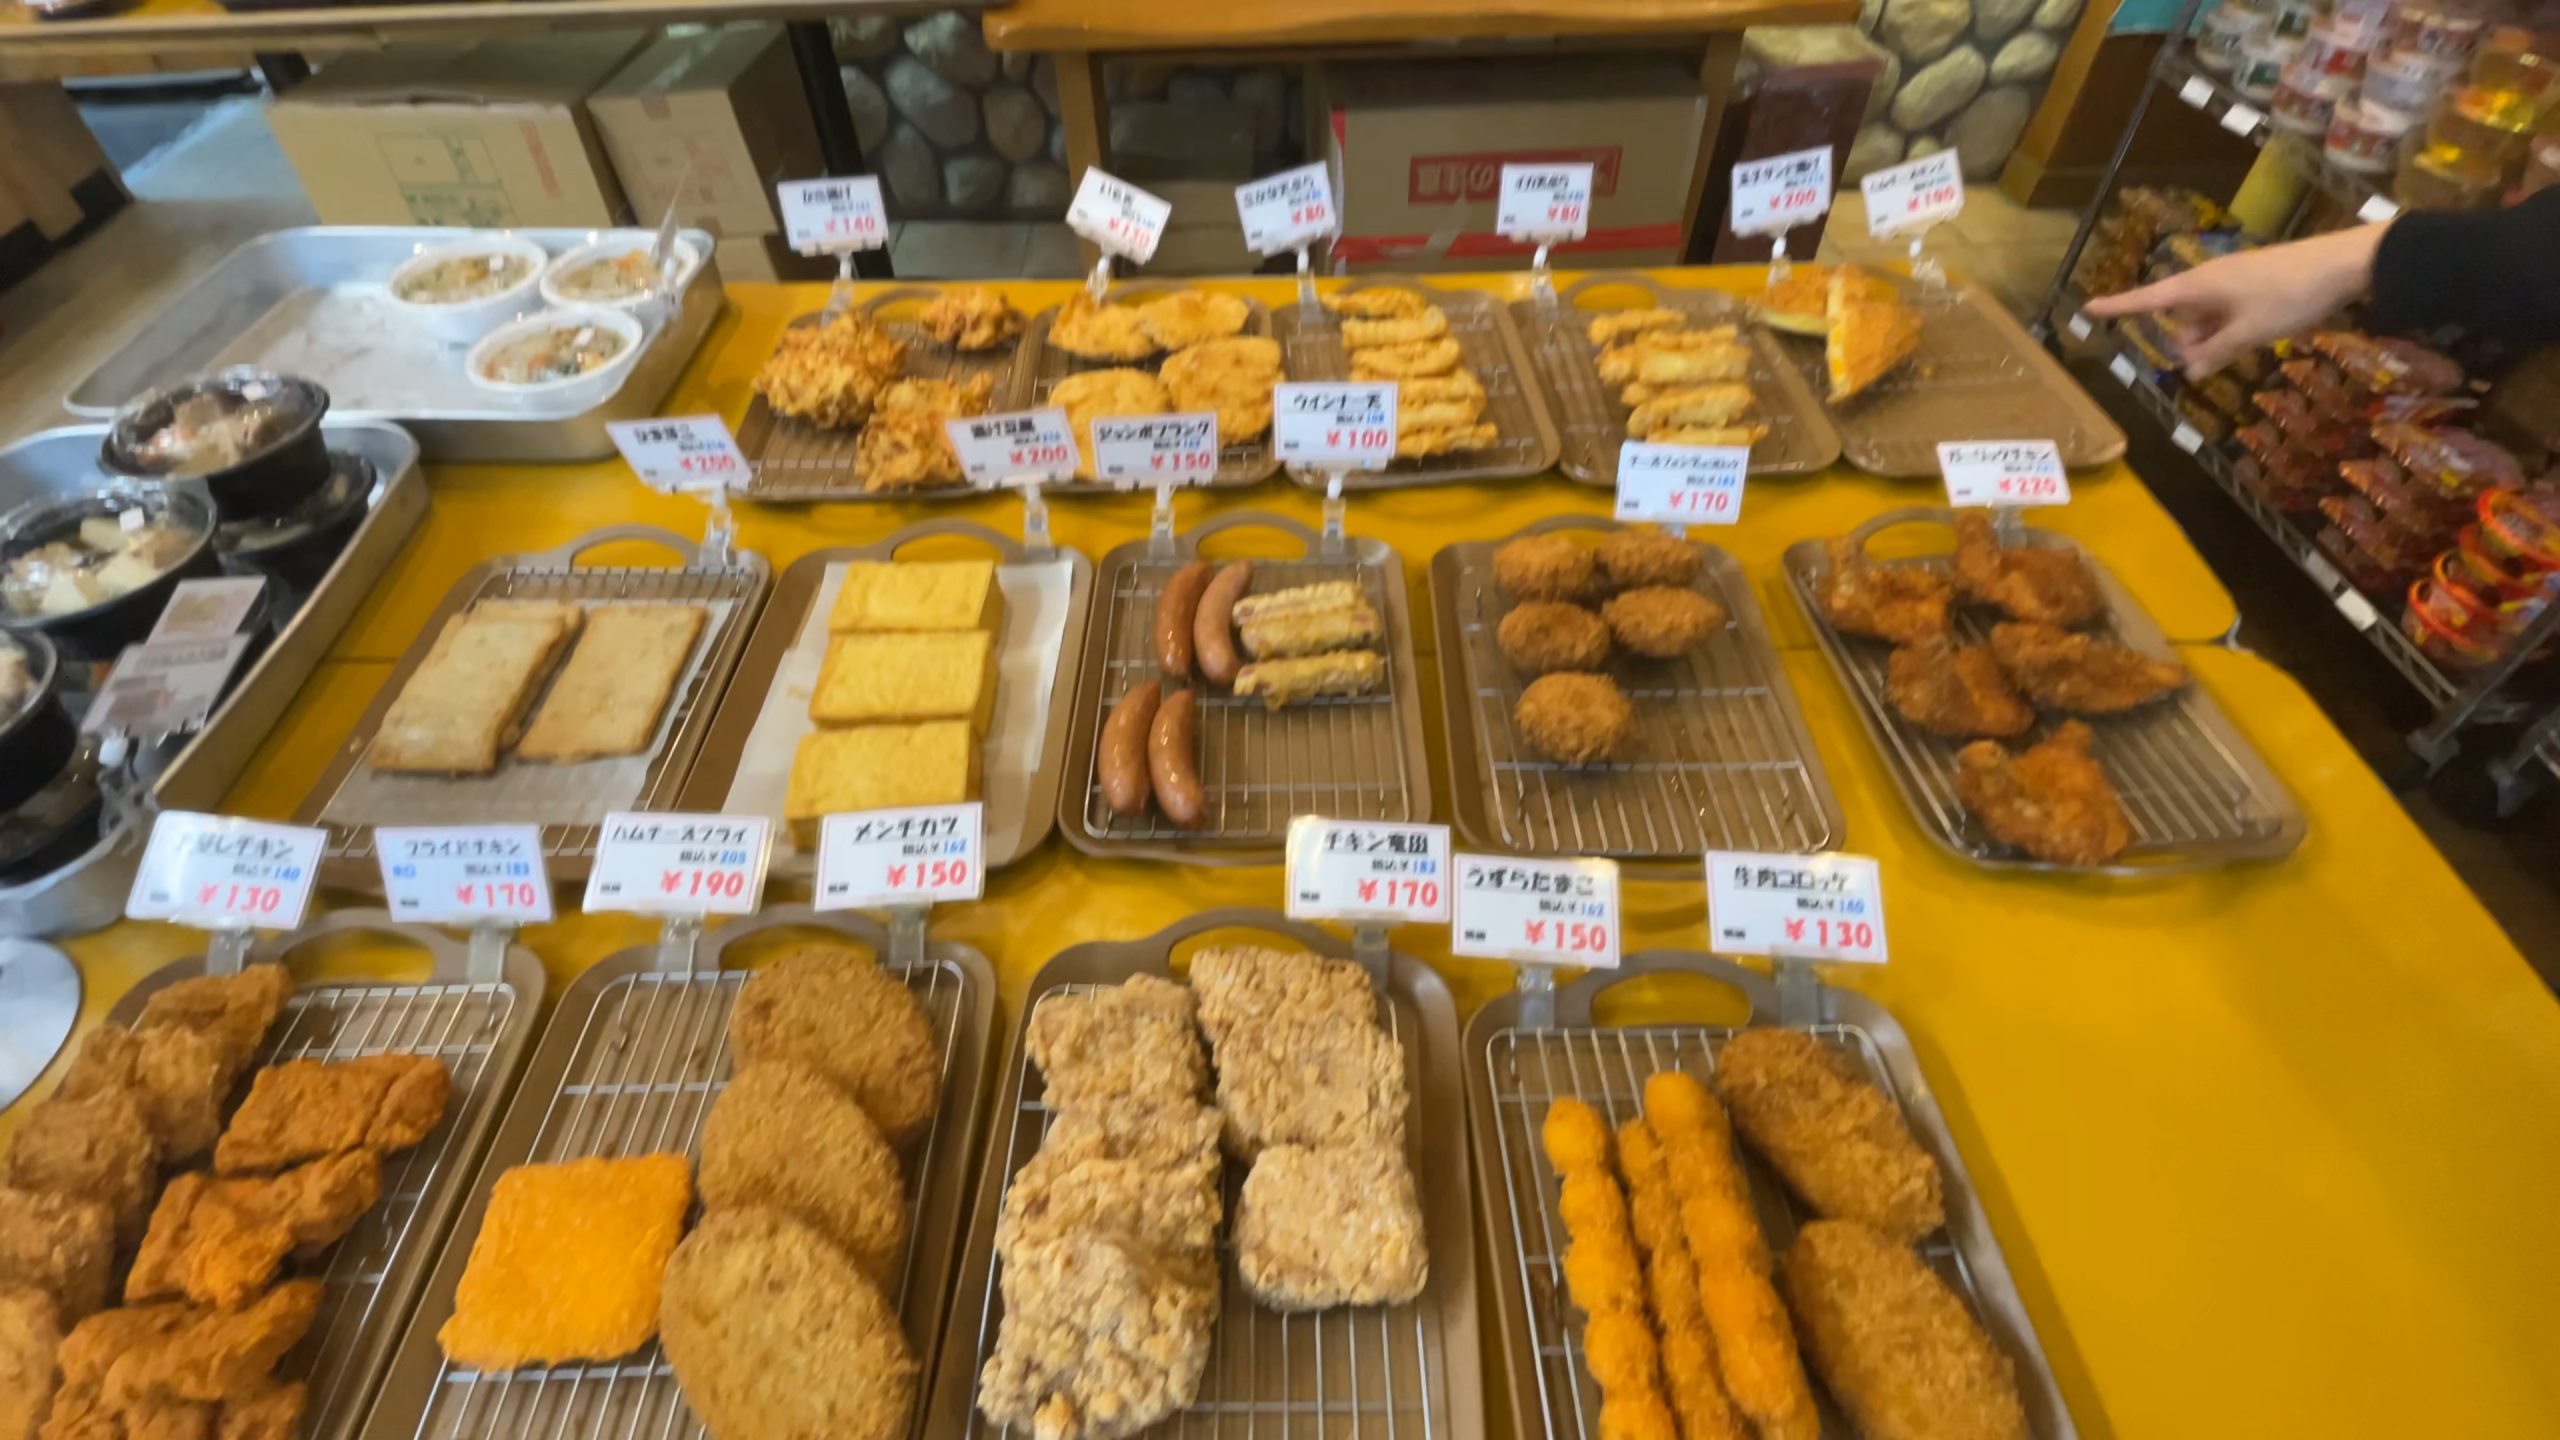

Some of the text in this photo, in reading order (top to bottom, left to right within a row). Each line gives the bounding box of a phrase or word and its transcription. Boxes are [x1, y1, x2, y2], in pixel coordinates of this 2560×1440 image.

[1327, 429, 1388, 450] ¥100
[1669, 491, 1728, 511] ¥170
[661, 870, 744, 898] ¥190
[887, 859, 967, 889] ¥150
[200, 883, 281, 913] ¥130
[456, 883, 535, 908] ¥170
[1359, 879, 1438, 907] ¥170
[1526, 919, 1607, 953] ¥150
[1784, 917, 1873, 948] ¥130
